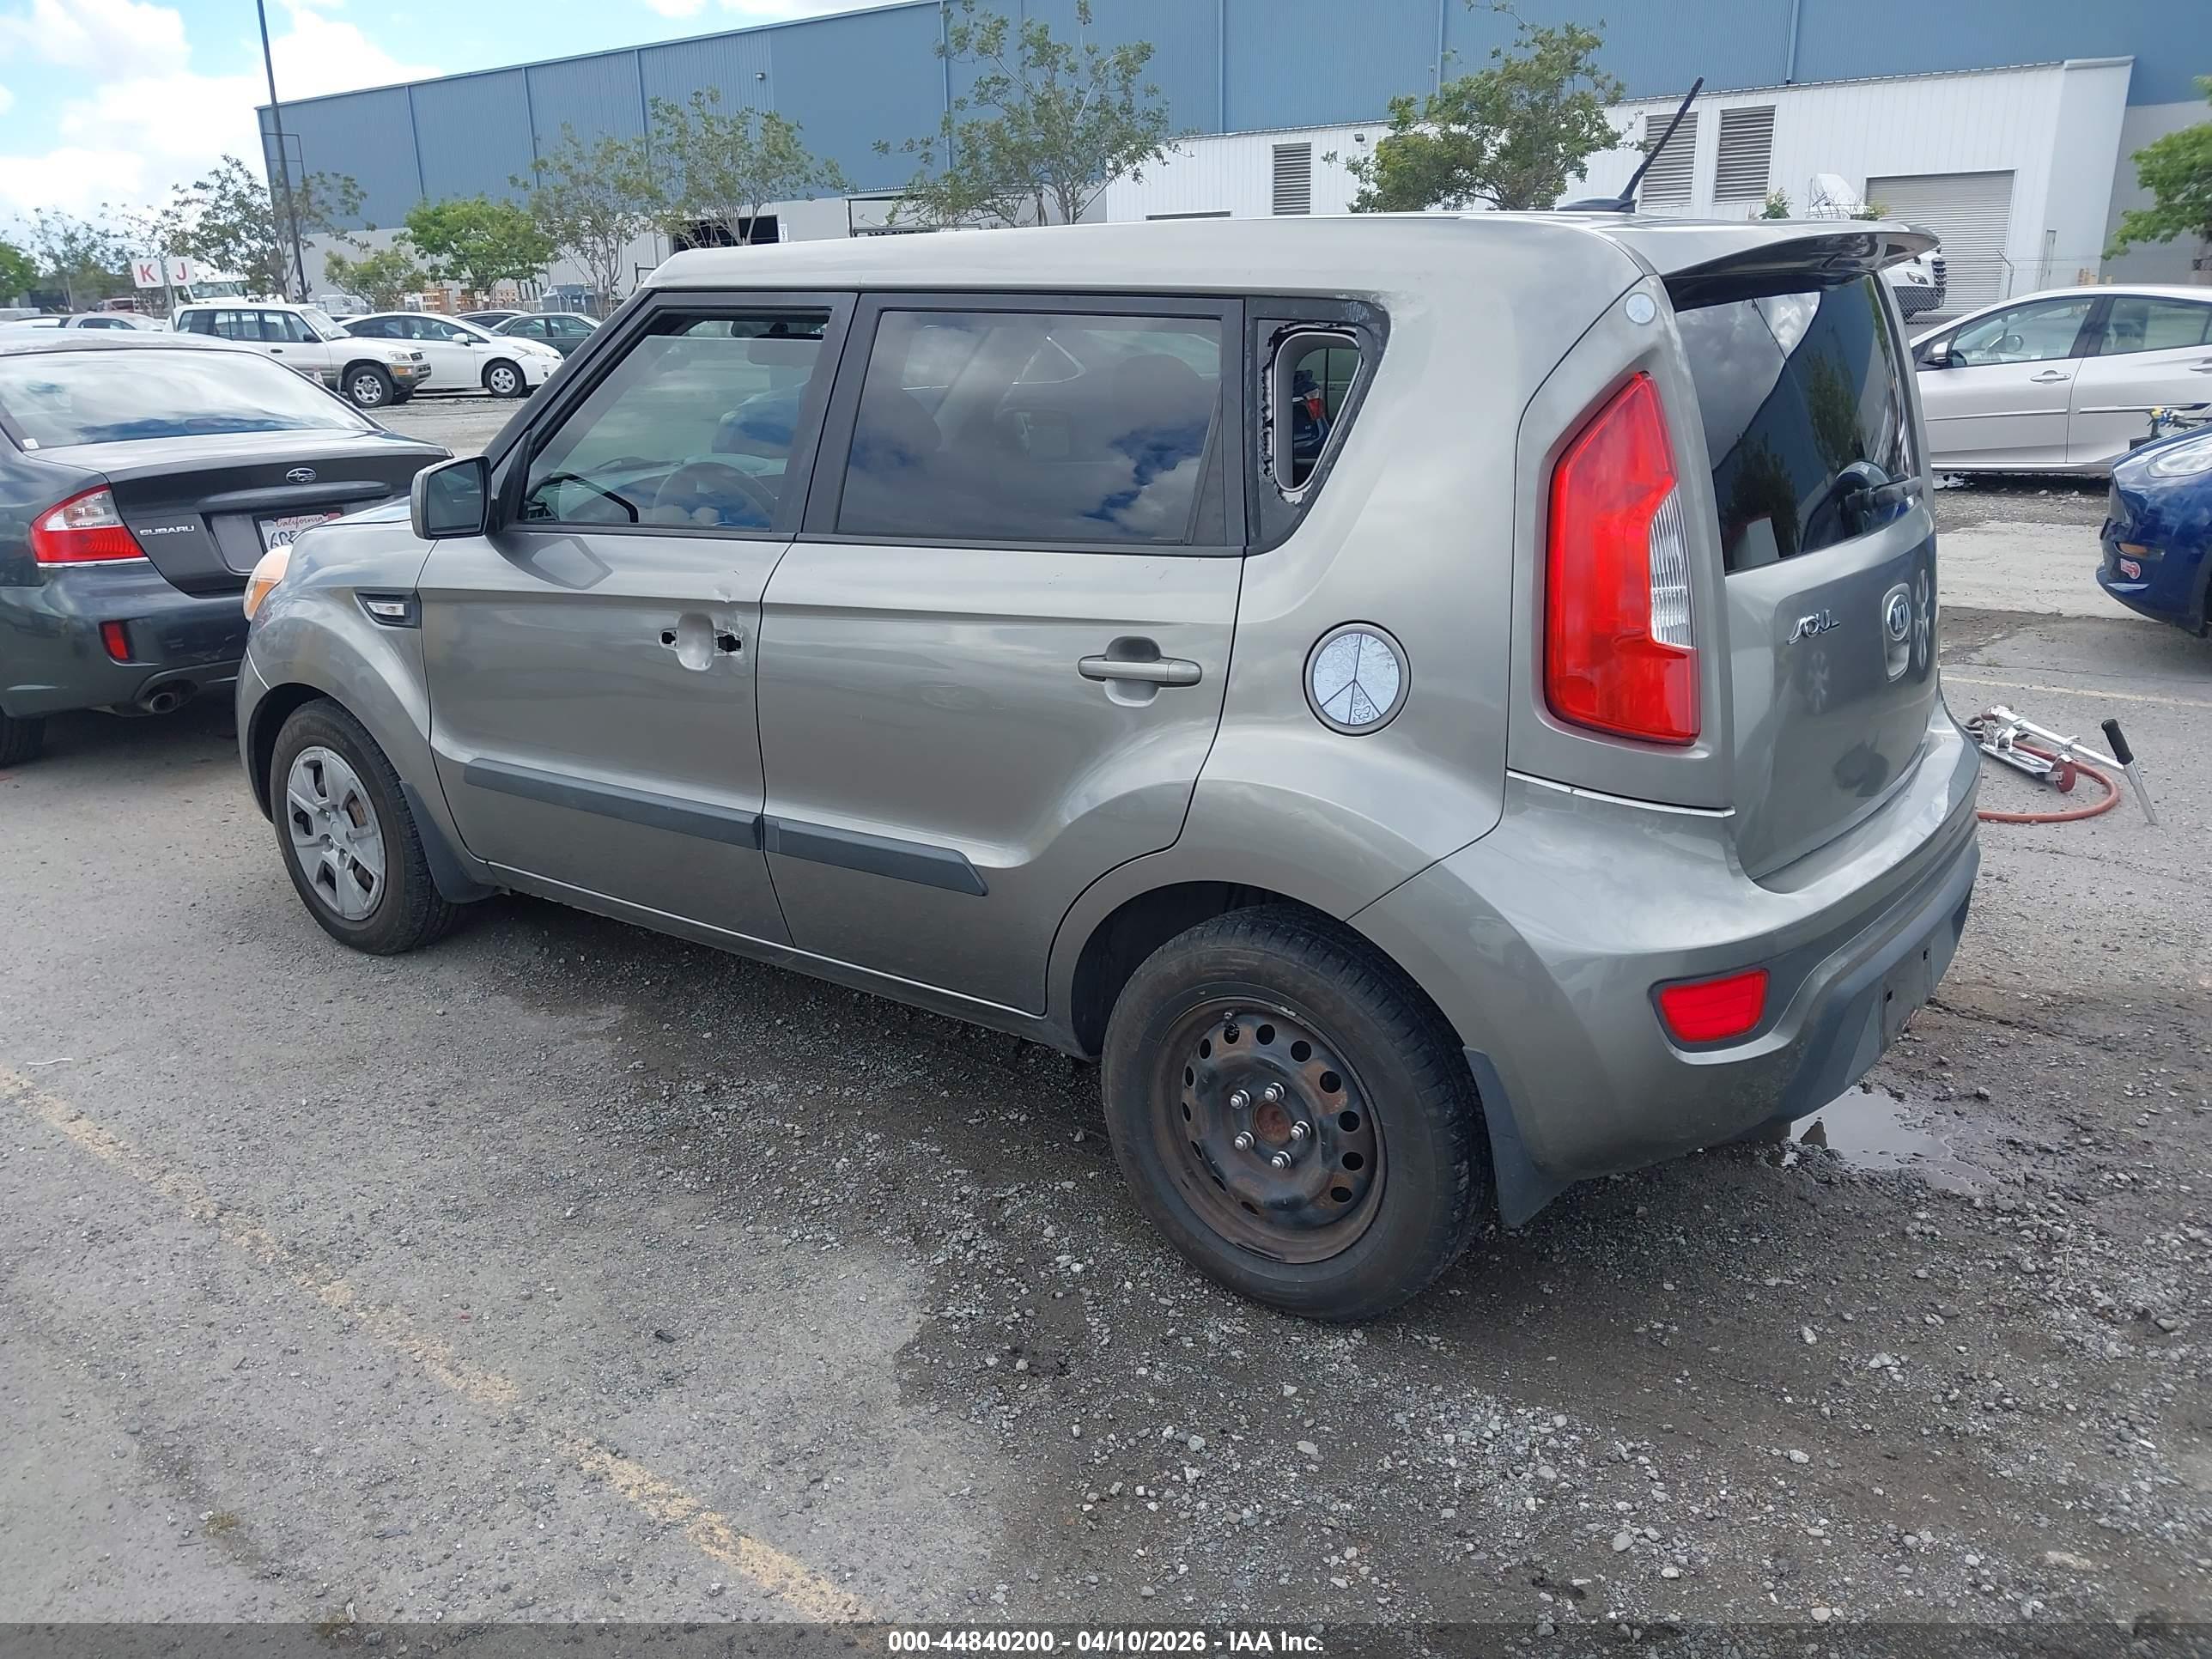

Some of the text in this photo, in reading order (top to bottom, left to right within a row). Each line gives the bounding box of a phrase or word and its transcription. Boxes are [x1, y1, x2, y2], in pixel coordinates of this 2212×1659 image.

[139, 264, 157, 283] K
[175, 262, 187, 281] J
[139, 525, 195, 536] SUBARU
